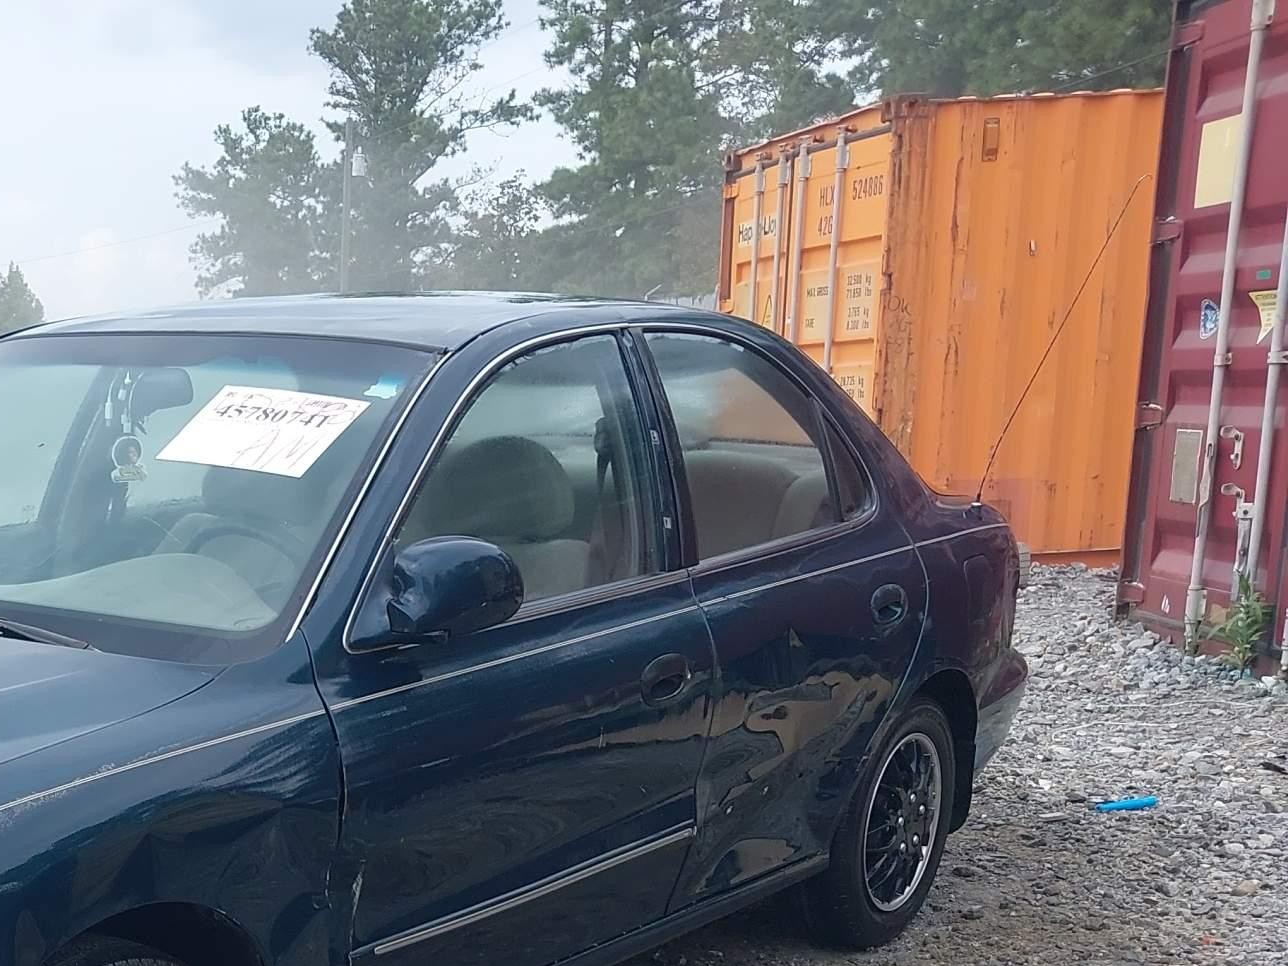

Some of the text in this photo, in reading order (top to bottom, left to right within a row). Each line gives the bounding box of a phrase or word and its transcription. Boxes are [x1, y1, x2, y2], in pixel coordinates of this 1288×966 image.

[819, 185, 836, 208] HLX
[818, 216, 834, 237] 42G
[215, 404, 329, 429] 45780741
